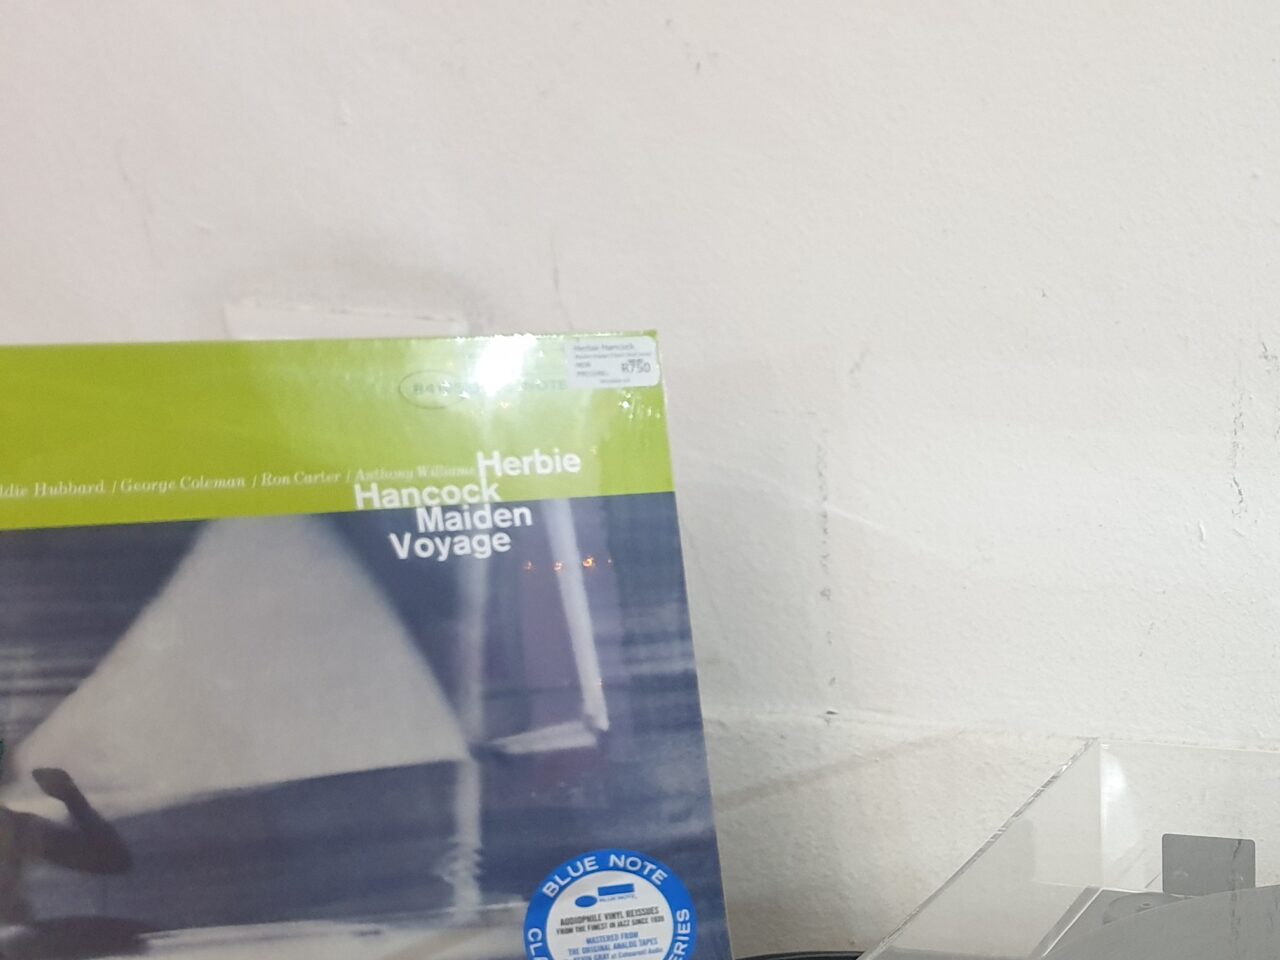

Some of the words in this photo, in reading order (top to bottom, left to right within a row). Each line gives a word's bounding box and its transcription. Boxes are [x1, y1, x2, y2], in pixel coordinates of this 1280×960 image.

[476, 448, 581, 478] Herbie
[34, 479, 106, 498] Hubbard
[120, 478, 175, 495] George
[179, 475, 246, 490] Coleman
[261, 471, 290, 486] Ron
[294, 469, 342, 484] Carter
[355, 467, 414, 483] Anthony
[354, 474, 502, 510] Hancock
[416, 503, 533, 534] Maiden
[389, 531, 512, 562] Voyage
[542, 855, 599, 898] BLUE
[609, 854, 668, 885] NOTE
[556, 926, 573, 935] FROM
[560, 912, 602, 926] AUDIOPHILE
[604, 910, 624, 921] VINYL
[625, 906, 659, 918] REISSUES
[620, 931, 639, 940] FROM
